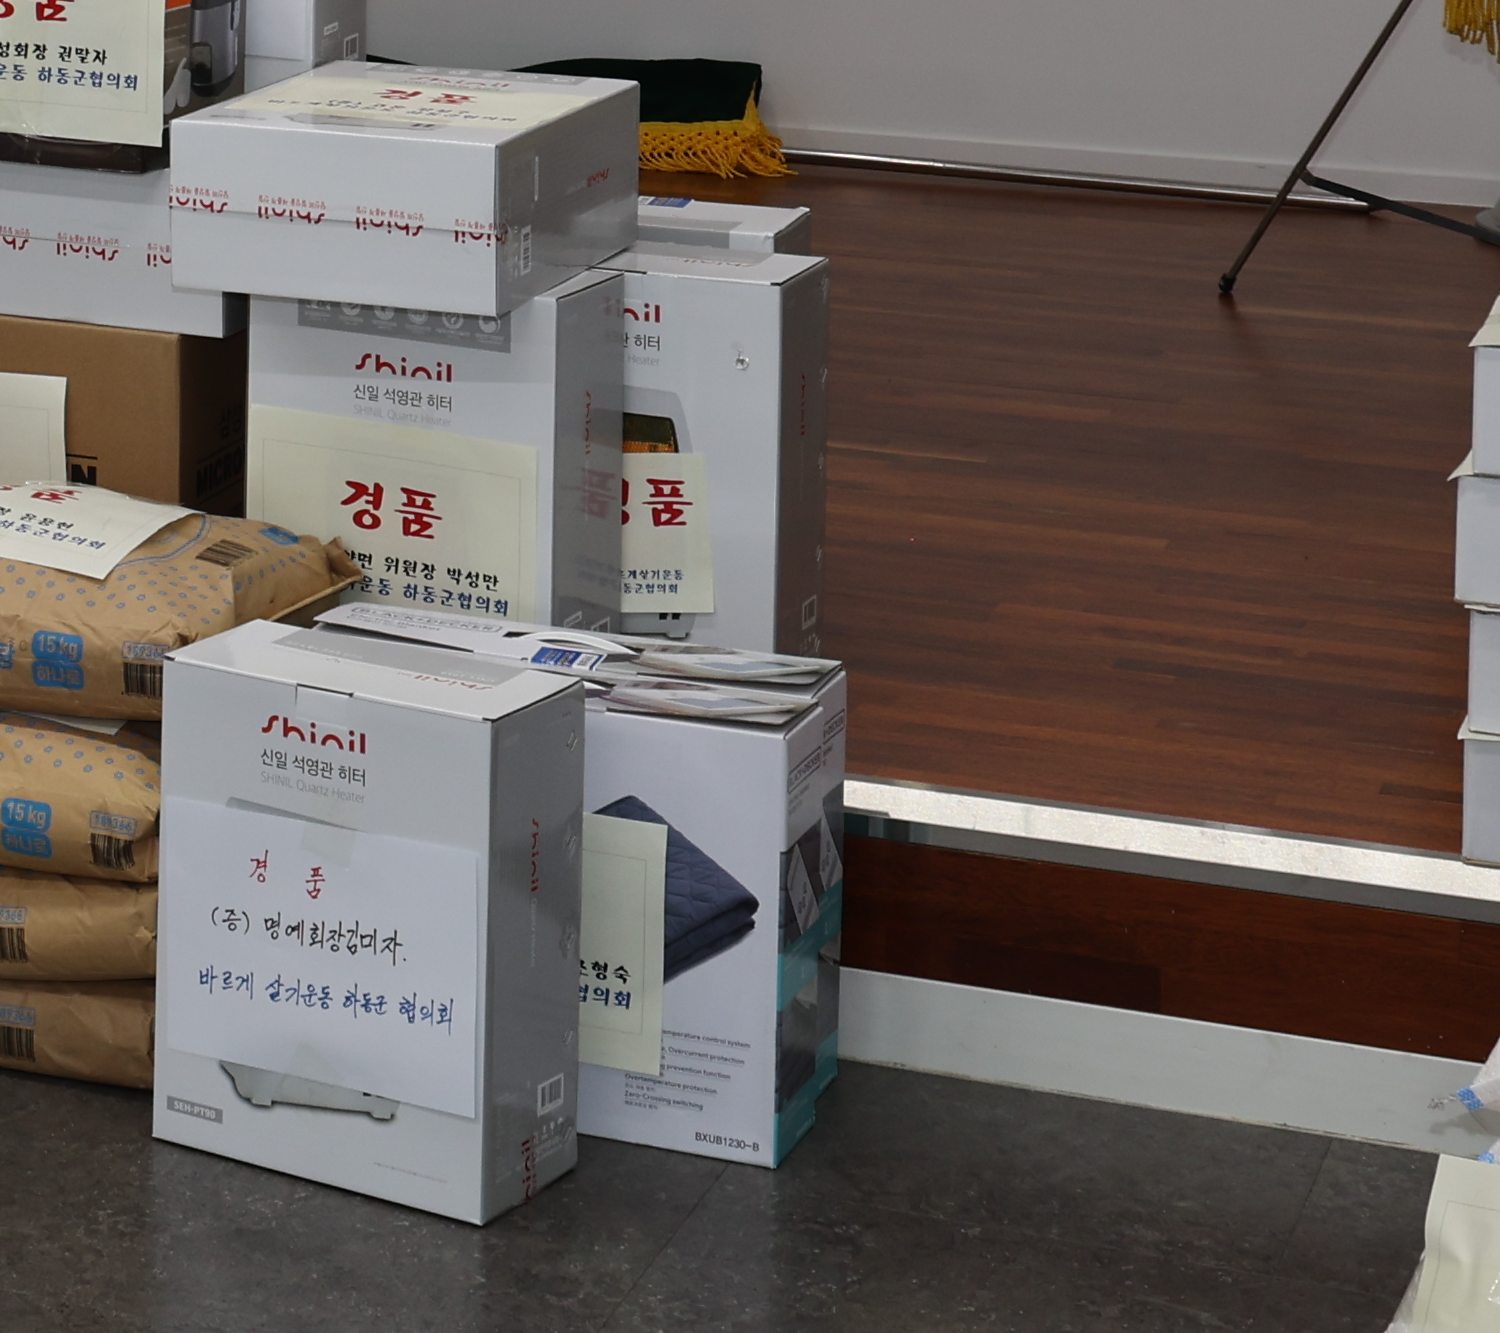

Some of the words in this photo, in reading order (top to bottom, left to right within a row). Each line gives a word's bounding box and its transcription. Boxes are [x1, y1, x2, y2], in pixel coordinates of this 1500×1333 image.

[58, 46, 108, 65] 권말자
[38, 67, 138, 91] 하동군협의회
[354, 385, 378, 402] 신일
[383, 388, 423, 407] 석영관
[427, 393, 452, 412] 히터
[341, 480, 442, 539] 경품
[384, 556, 435, 580] 위원장
[447, 565, 499, 592] 박성만
[261, 749, 288, 771] 신일
[293, 755, 333, 780] 석영관
[338, 764, 366, 787] 히터
[261, 771, 292, 788] SHINIL
[296, 778, 329, 797] Quartz
[332, 787, 365, 804] Heater
[174, 1100, 216, 1120] SEH-PT90
[695, 1132, 759, 1152] BXUB1230-B
